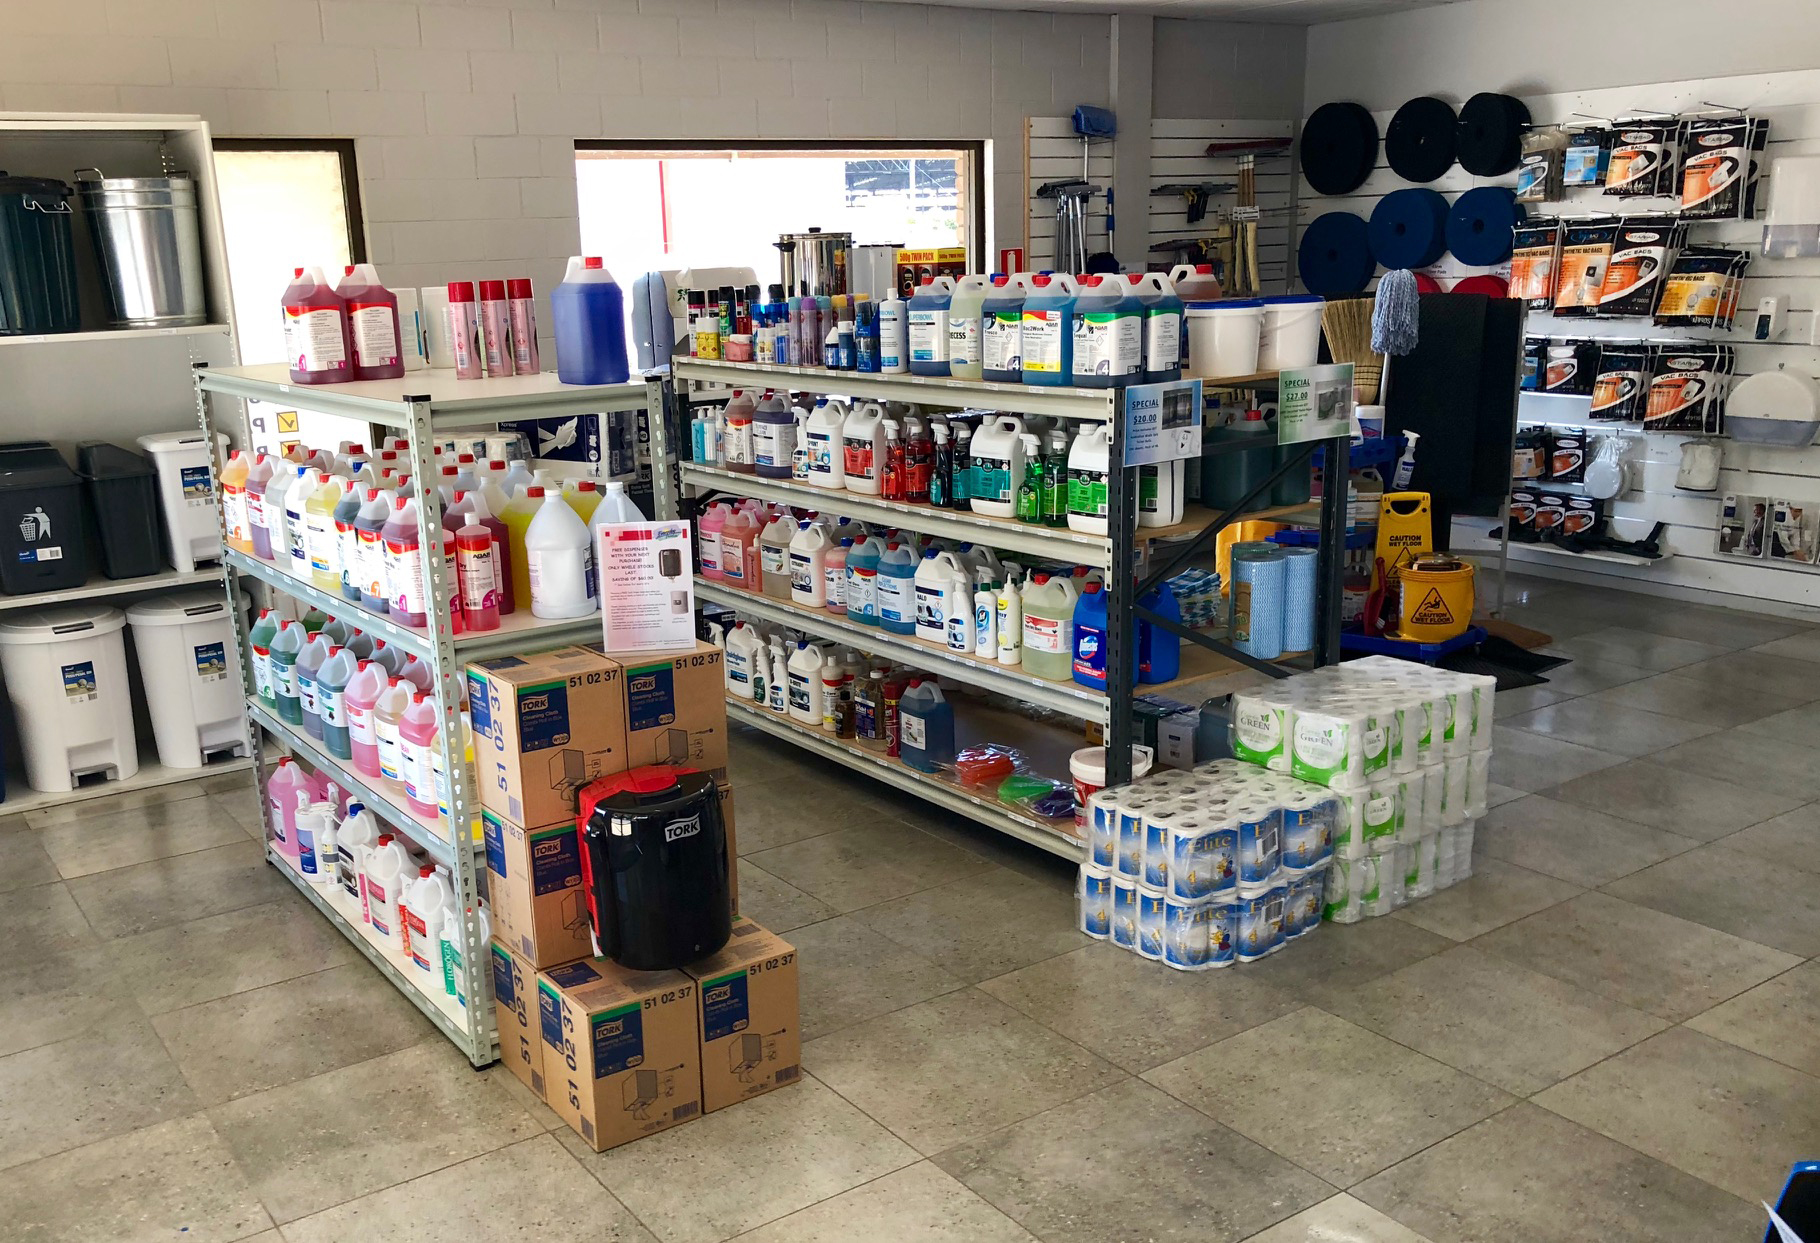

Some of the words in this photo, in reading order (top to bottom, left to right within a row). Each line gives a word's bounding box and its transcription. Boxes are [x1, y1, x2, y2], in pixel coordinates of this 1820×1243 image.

[1694, 154, 1708, 162] VAC
[899, 251, 911, 263] 500g
[911, 251, 922, 262] TWIN
[922, 251, 935, 261] PACK
[909, 313, 934, 321] UPERBOWL
[949, 331, 967, 340] ECESS
[1012, 359, 1020, 369] 4
[1101, 364, 1109, 372] 4
[1285, 378, 1310, 388] SPECIAL
[1132, 398, 1159, 409] SPECIAL
[1286, 391, 1308, 403] $27.00
[1133, 413, 1157, 425] $20.00
[374, 583, 381, 597] 7
[490, 594, 496, 606] 1
[867, 606, 873, 614] 5
[675, 658, 688, 670] 51
[691, 655, 705, 667] 02
[707, 652, 720, 664] 37
[569, 676, 582, 688] 51
[586, 672, 601, 685] 02
[604, 669, 618, 682] 37
[631, 679, 655, 691] TORK
[488, 677, 499, 712] 37
[522, 698, 548, 712] TORK
[523, 712, 545, 721] Cleaning
[1240, 716, 1271, 731] GREEN
[493, 719, 505, 752] 02
[1300, 733, 1333, 748] GREEN
[496, 762, 508, 792] 51
[667, 820, 698, 839] TORK
[536, 843, 559, 856] TORK
[1187, 869, 1197, 885] 4
[1097, 908, 1106, 922] 4
[1249, 928, 1258, 944] 4
[750, 963, 762, 976] 51
[765, 958, 779, 971] 02
[781, 953, 794, 966] 37
[512, 957, 524, 992] 37
[644, 997, 657, 1010] 51
[661, 991, 676, 1004] 02
[678, 986, 692, 999] 37
[706, 988, 729, 1001] TORK
[516, 995, 527, 1028] 02
[561, 996, 574, 1034] 37
[597, 1024, 621, 1038] TORK
[520, 1035, 531, 1065] 51
[565, 1037, 577, 1072] 02
[567, 1078, 580, 1111] 51
